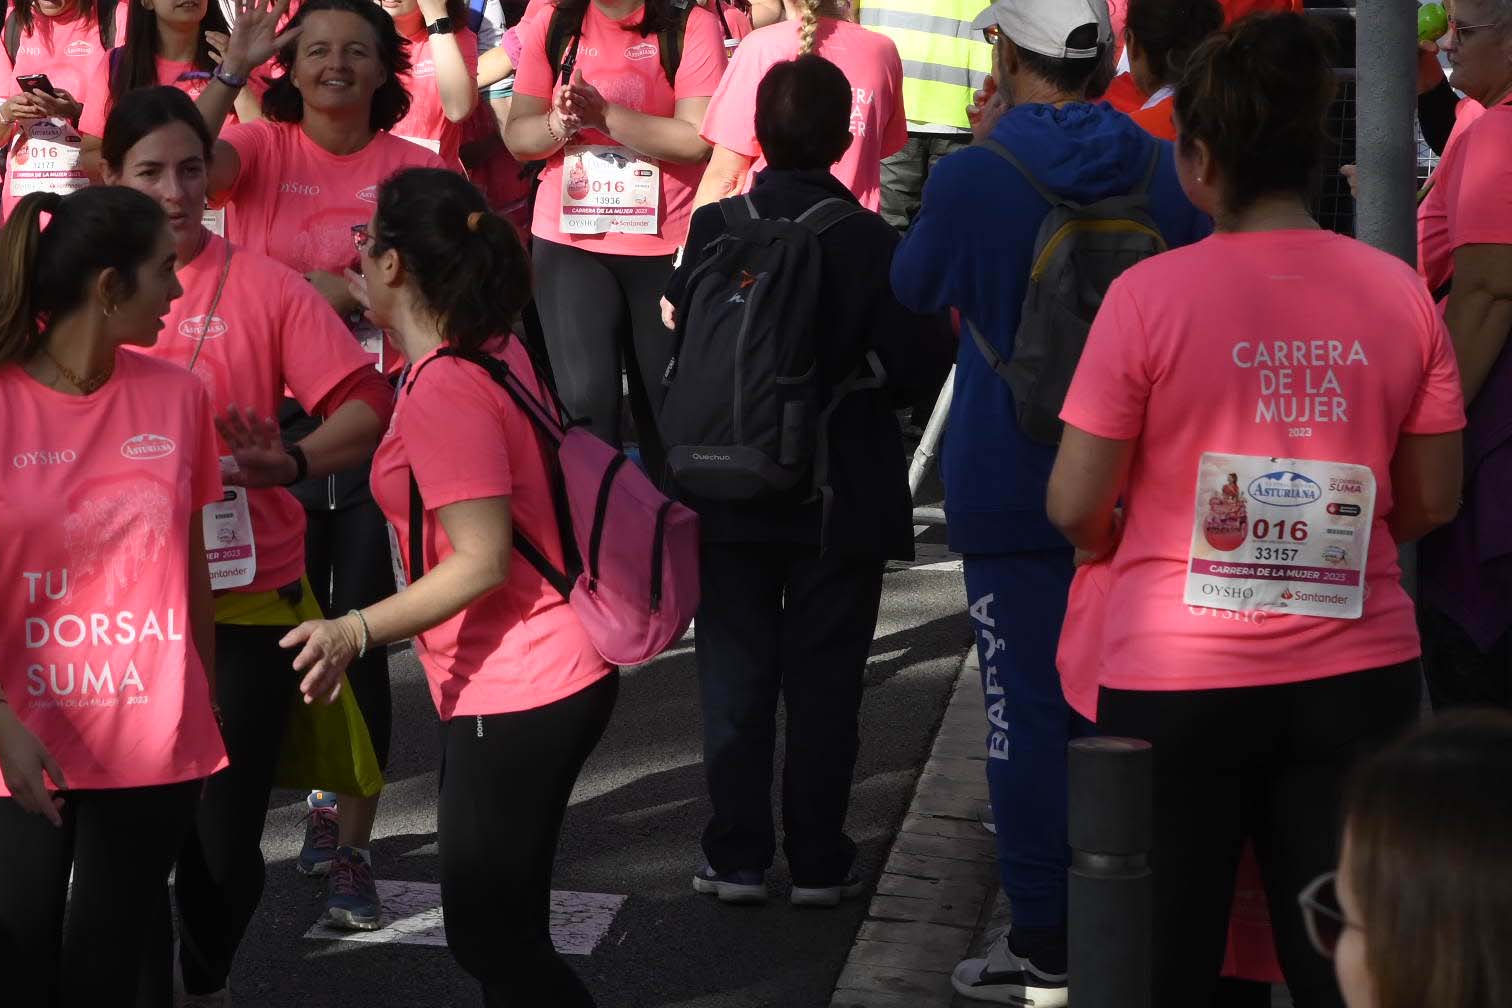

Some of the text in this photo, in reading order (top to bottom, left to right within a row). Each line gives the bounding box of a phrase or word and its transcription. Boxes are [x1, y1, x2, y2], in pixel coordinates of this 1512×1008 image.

[851, 87, 874, 104] RA
[31, 147, 58, 158] 016
[592, 180, 625, 193] 016
[1232, 340, 1369, 368] CARRERA
[1259, 367, 1342, 395] DE LA
[1255, 396, 1349, 423] MUJER
[1288, 427, 1313, 438] 2023
[125, 444, 172, 456] ASTURIANA
[692, 453, 731, 461] Quechua
[13, 448, 77, 469] OYSHO
[1253, 484, 1317, 500] ASTURIANA
[1328, 483, 1362, 493] SUMA
[1252, 519, 1308, 541] 016
[1255, 547, 1299, 562] 33157
[1209, 565, 1255, 576] CARRERA
[1257, 567, 1271, 576] DE
[1272, 568, 1285, 577] LA
[1288, 569, 1320, 580] MUJER
[23, 569, 68, 603] TU
[1202, 583, 1349, 606] OYSHO Santander
[25, 607, 184, 648] DORSAL
[26, 659, 145, 696] SUMA
[127, 695, 149, 705] 2023
